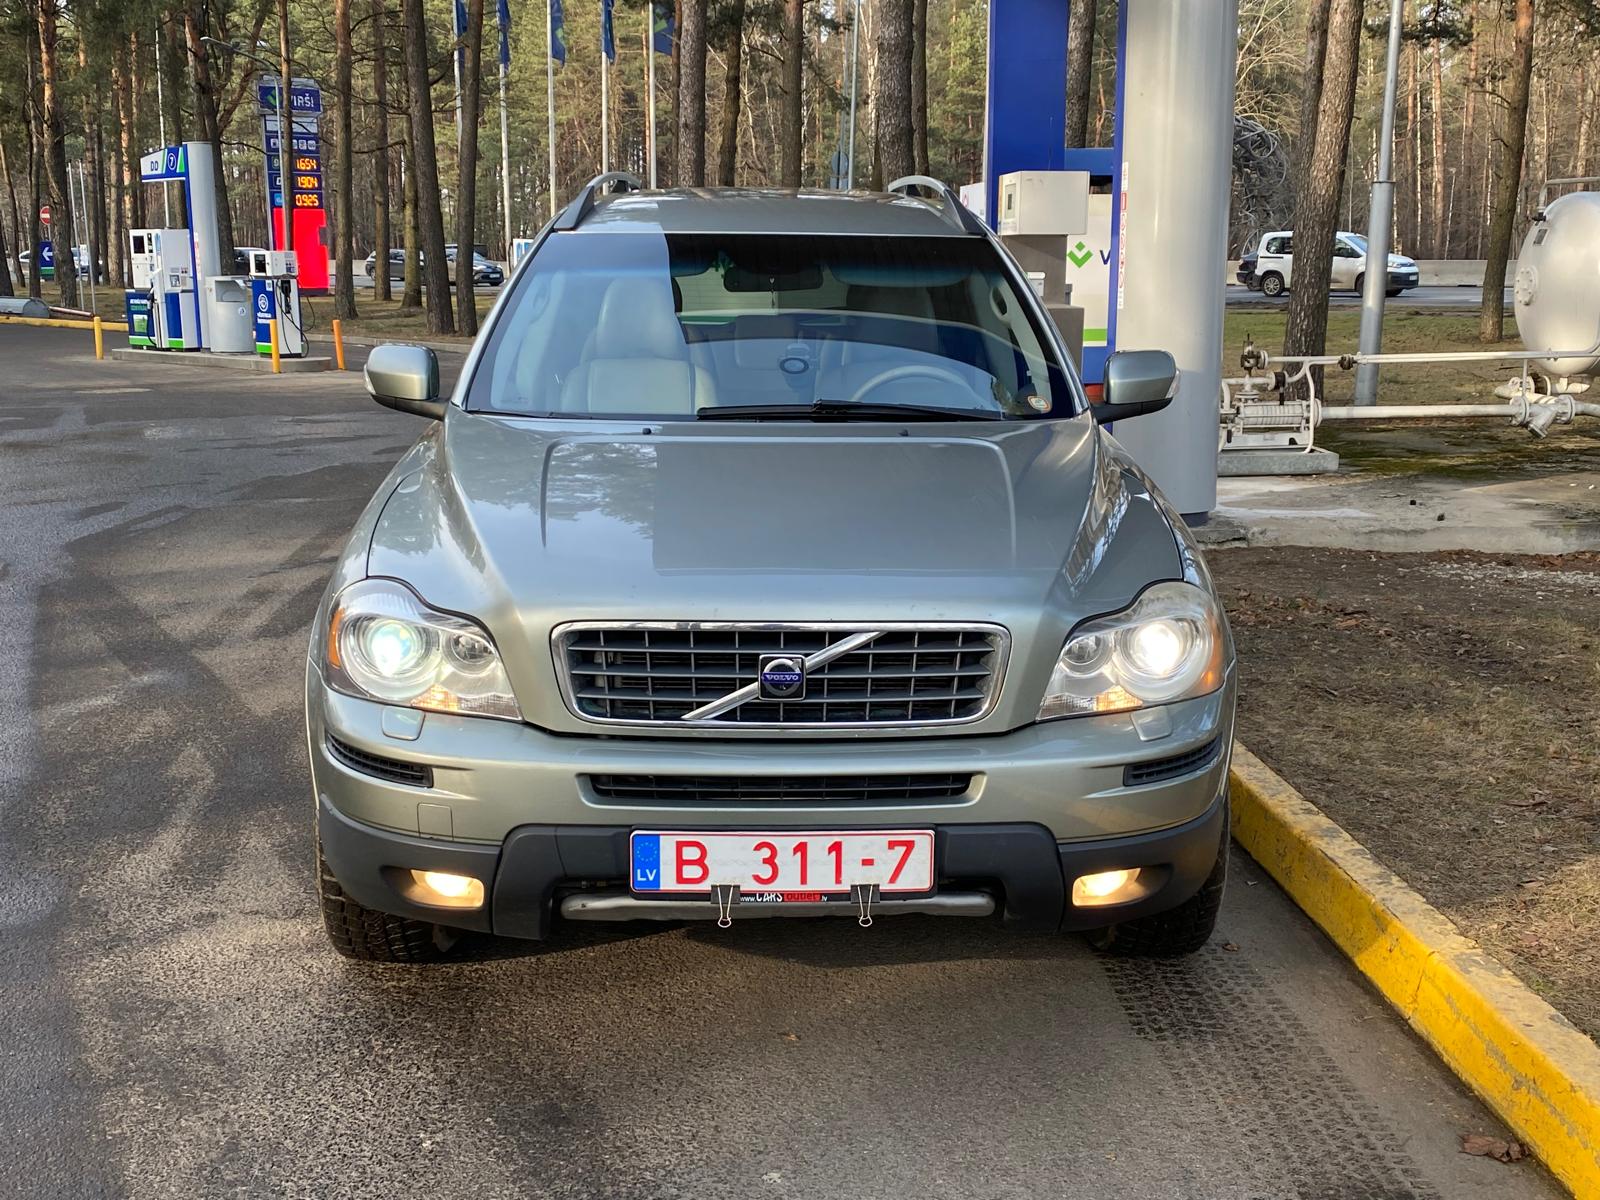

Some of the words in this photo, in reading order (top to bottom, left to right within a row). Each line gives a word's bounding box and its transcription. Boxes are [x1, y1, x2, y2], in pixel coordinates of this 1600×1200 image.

[150, 160, 159, 171] DD
[675, 840, 710, 885] B
[752, 840, 915, 886] 311-7
[637, 869, 657, 882] LV
